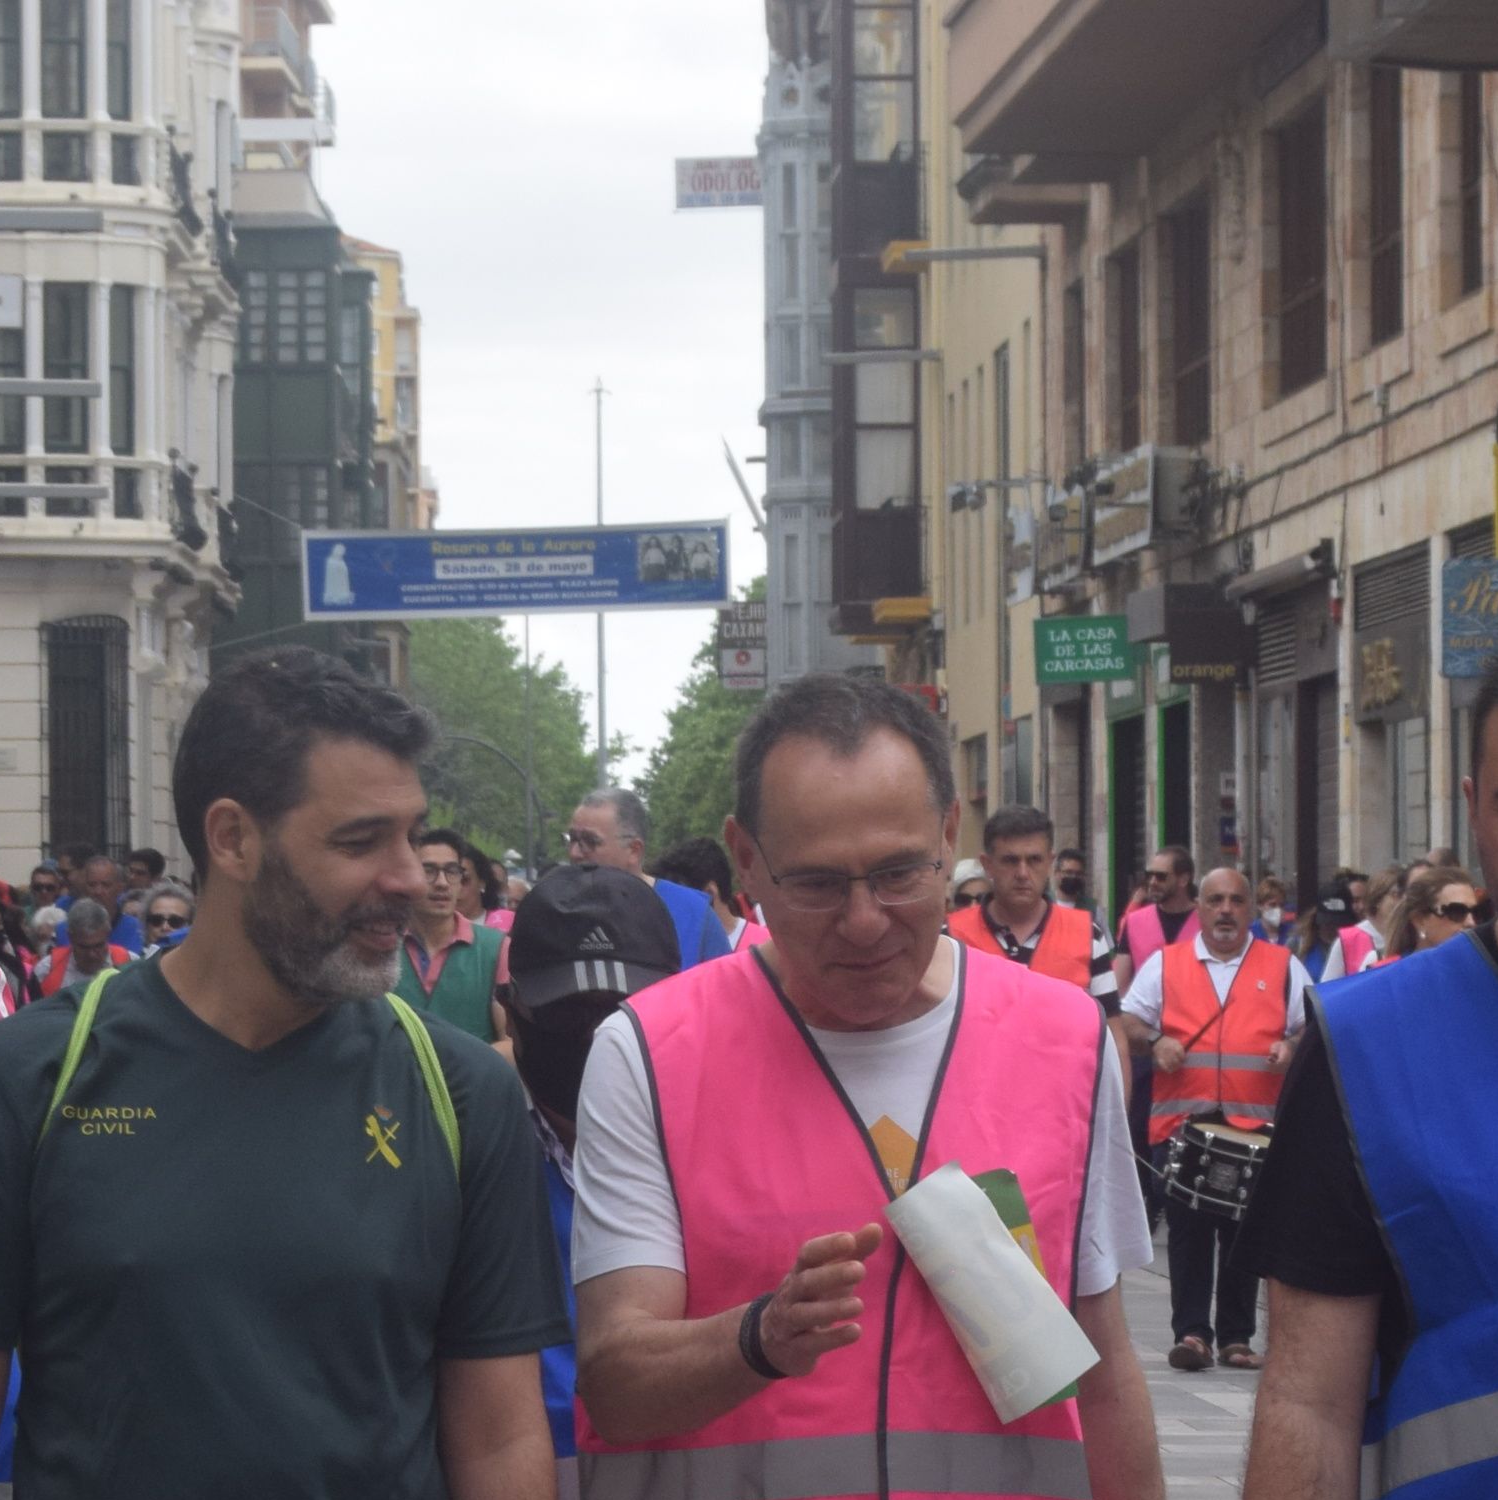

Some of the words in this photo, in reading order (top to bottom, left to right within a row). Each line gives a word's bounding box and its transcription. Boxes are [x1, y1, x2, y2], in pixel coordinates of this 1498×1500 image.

[430, 540, 489, 556] Rosario
[495, 540, 515, 555] de
[520, 539, 535, 553] la
[542, 538, 596, 553] Aurora
[526, 559, 543, 573] de
[548, 560, 586, 575] mayo
[1049, 628, 1071, 643] LA
[1076, 625, 1118, 642] CASA
[1054, 643, 1076, 658] DE
[1084, 641, 1113, 656] LAS
[1044, 656, 1125, 673] CARCASAS
[1171, 663, 1237, 680] orange
[579, 941, 615, 952] adidas
[61, 1105, 157, 1120] GUARDIA
[81, 1122, 136, 1136] CIVIL
